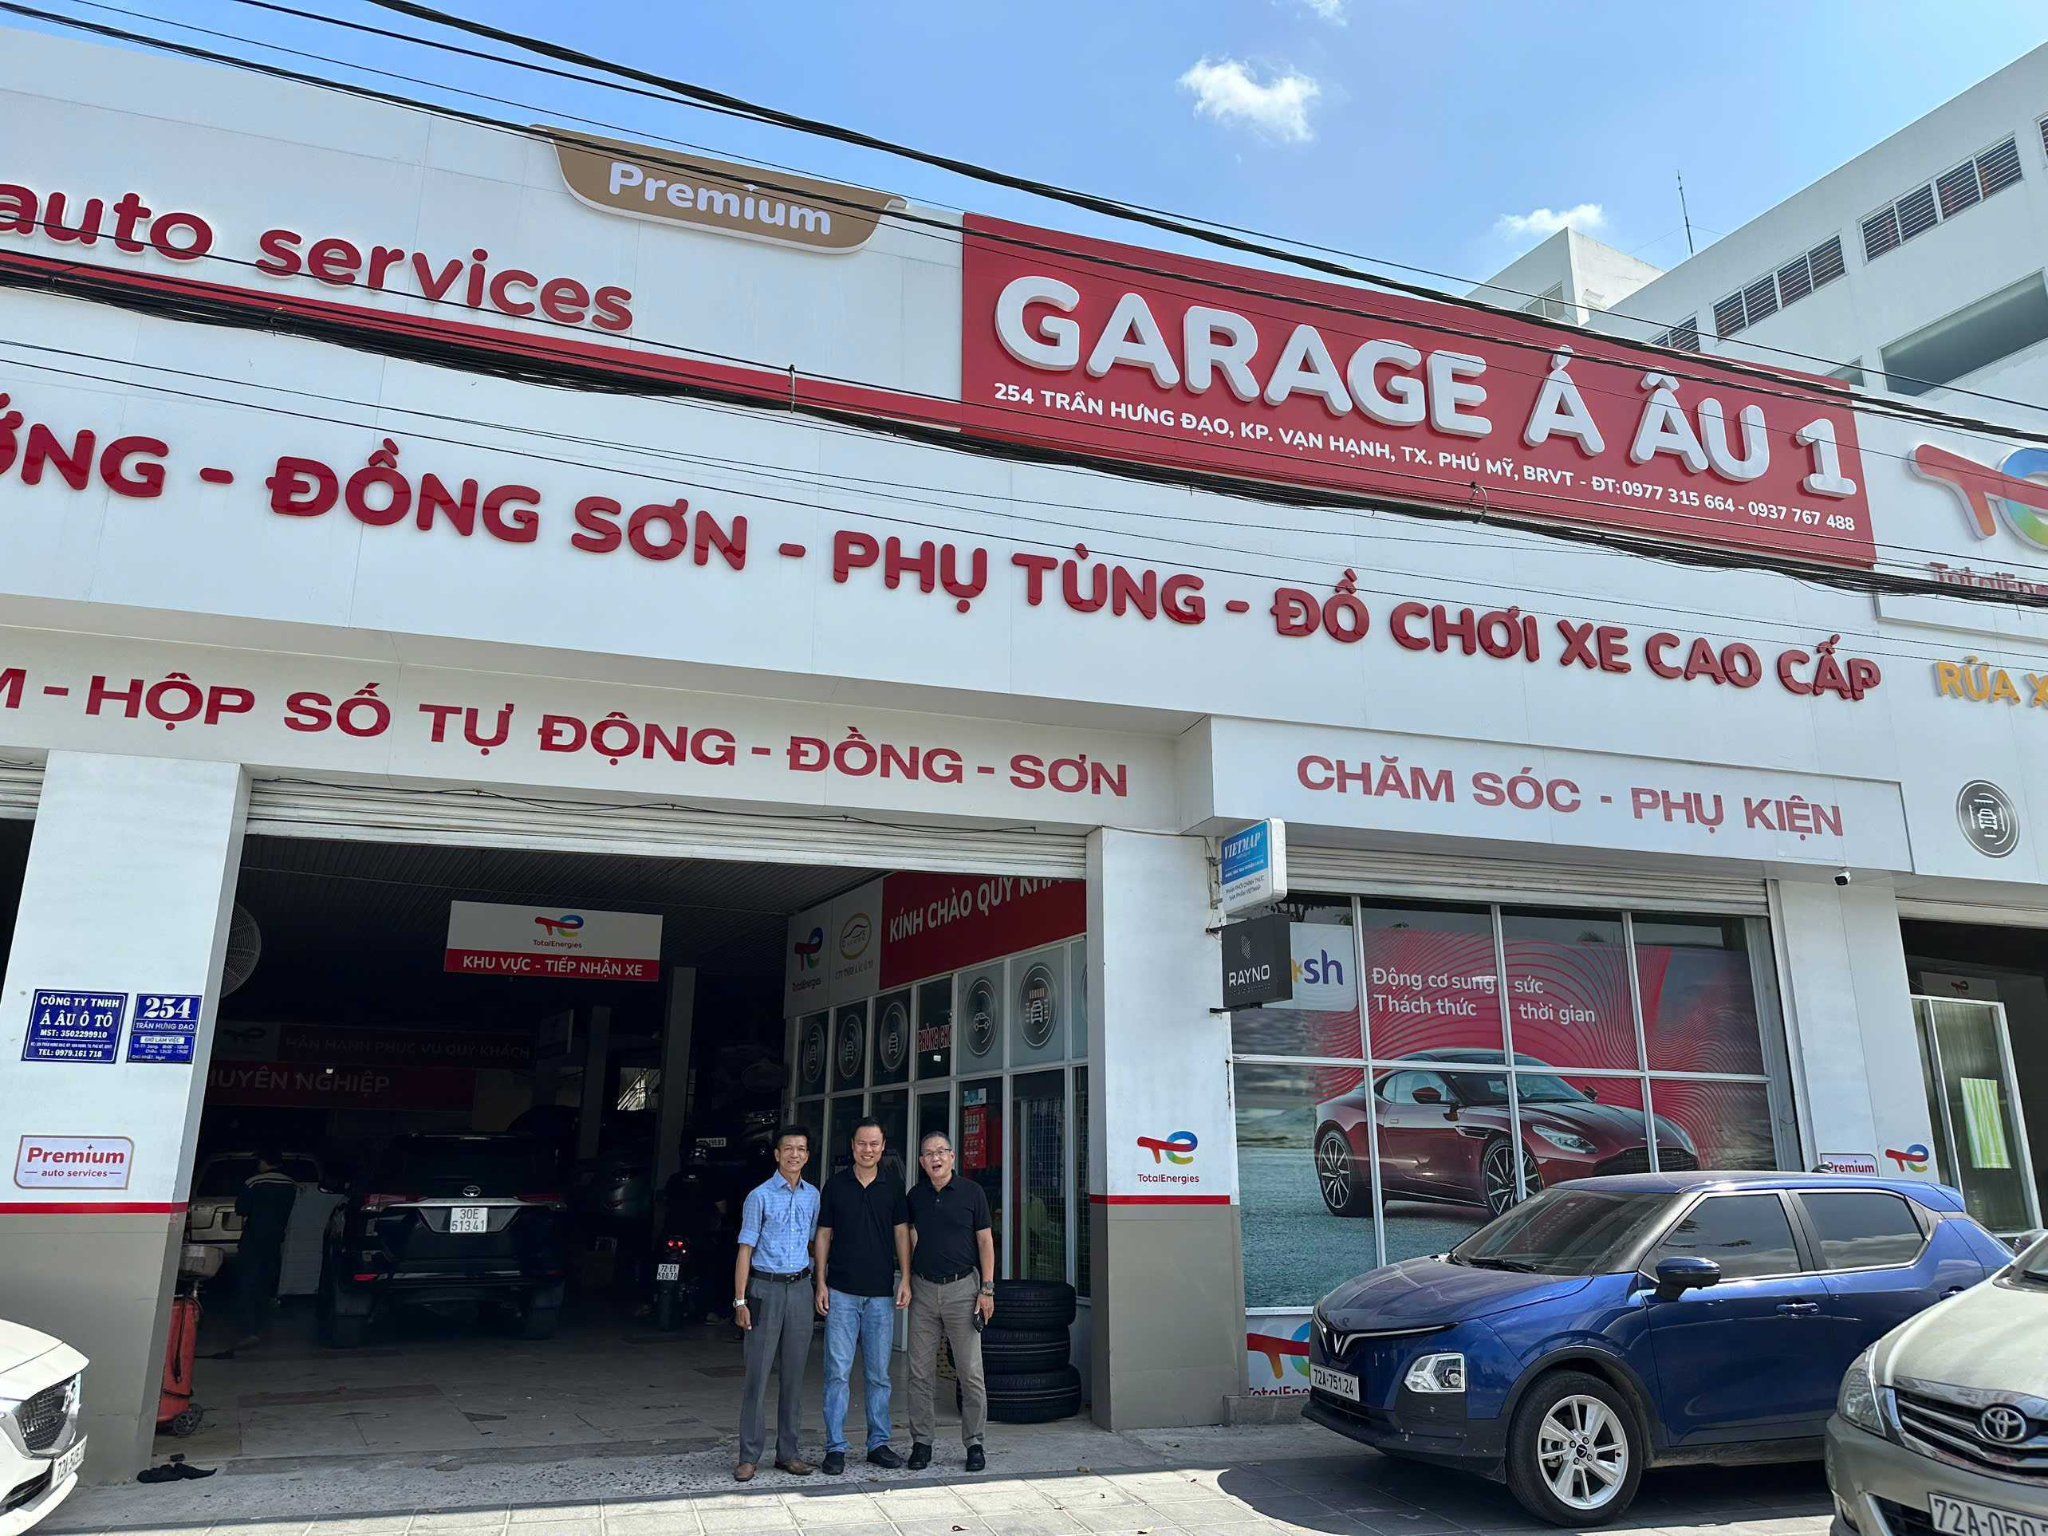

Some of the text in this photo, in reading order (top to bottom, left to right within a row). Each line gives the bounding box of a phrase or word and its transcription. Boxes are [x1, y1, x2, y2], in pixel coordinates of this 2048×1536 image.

[608, 160, 833, 237] Premium
[0, 183, 634, 332] auto services
[994, 276, 1858, 499] GARAGE Á ÂU 1
[994, 382, 1034, 404] 254
[1041, 390, 1103, 416] TRẦN
[1110, 401, 1175, 427] HƯNG
[1179, 412, 1235, 438] ĐẠO,
[1240, 421, 1273, 442] KP.
[1278, 427, 1323, 450] VẠN
[1329, 435, 1396, 463] HẠNH,
[1400, 446, 1432, 465] TX.
[1438, 452, 1481, 473] PHÚ
[1485, 458, 1519, 481] MỸ,
[1522, 465, 1575, 487] BRVT
[1667, 487, 1700, 507] 315
[1703, 493, 1736, 513] 664
[1747, 500, 1788, 521] 0937
[1791, 507, 1822, 526] 767
[1825, 513, 1856, 533] 488
[265, 437, 541, 544] ĐỒNG
[571, 496, 748, 571] SƠN
[833, 530, 988, 614] PHỤ
[1012, 543, 1206, 625] TÙNG
[1271, 568, 1369, 643] ĐỒ
[1390, 601, 1541, 662] CHƠI
[1557, 619, 1631, 674] XE
[1645, 633, 1762, 688] CAO
[1777, 634, 1881, 701] CẤP
[1934, 655, 2021, 704] RỬA
[86, 672, 256, 731] HỘP
[284, 682, 391, 737] SỐ
[419, 702, 514, 756] TỰ
[537, 711, 736, 766] ĐỘNG
[786, 726, 964, 784] ĐỒNG
[1009, 753, 1128, 797] SƠN
[1297, 755, 1455, 803] CHĂM
[1472, 767, 1581, 813] SÓC
[1633, 787, 1725, 834] PHỤ
[1745, 795, 1844, 842] KIỆN
[1224, 832, 1261, 860] VIETMAP
[889, 907, 923, 943] KÍNH
[927, 887, 972, 929] CHÀO
[533, 939, 583, 950] TotalEnergies
[463, 955, 496, 970] KHU
[500, 957, 531, 973] VỰC
[545, 956, 577, 972] TIẾP
[579, 959, 622, 977] NHẬN
[625, 964, 643, 976] XE
[1228, 964, 1270, 987] RAYNO
[1371, 966, 1422, 990] Động
[1428, 973, 1448, 989] cơ
[1515, 974, 1544, 994] sức
[40, 994, 120, 1008] CÔNG TY TNHH
[143, 997, 191, 1019] 254
[1373, 994, 1595, 1025] Thách thức thời gian
[39, 1009, 113, 1027] Á ÂU Ô TÔ
[39, 1029, 59, 1037] MST:
[89, 1050, 103, 1058] 718
[295, 1069, 390, 1098] NGHIỆP
[27, 1144, 125, 1165] Premium
[41, 1168, 108, 1178] auto services
[1137, 1174, 1200, 1184] TotalEnergies
[451, 1220, 485, 1232] 513.41
[459, 1208, 480, 1220] 30E
